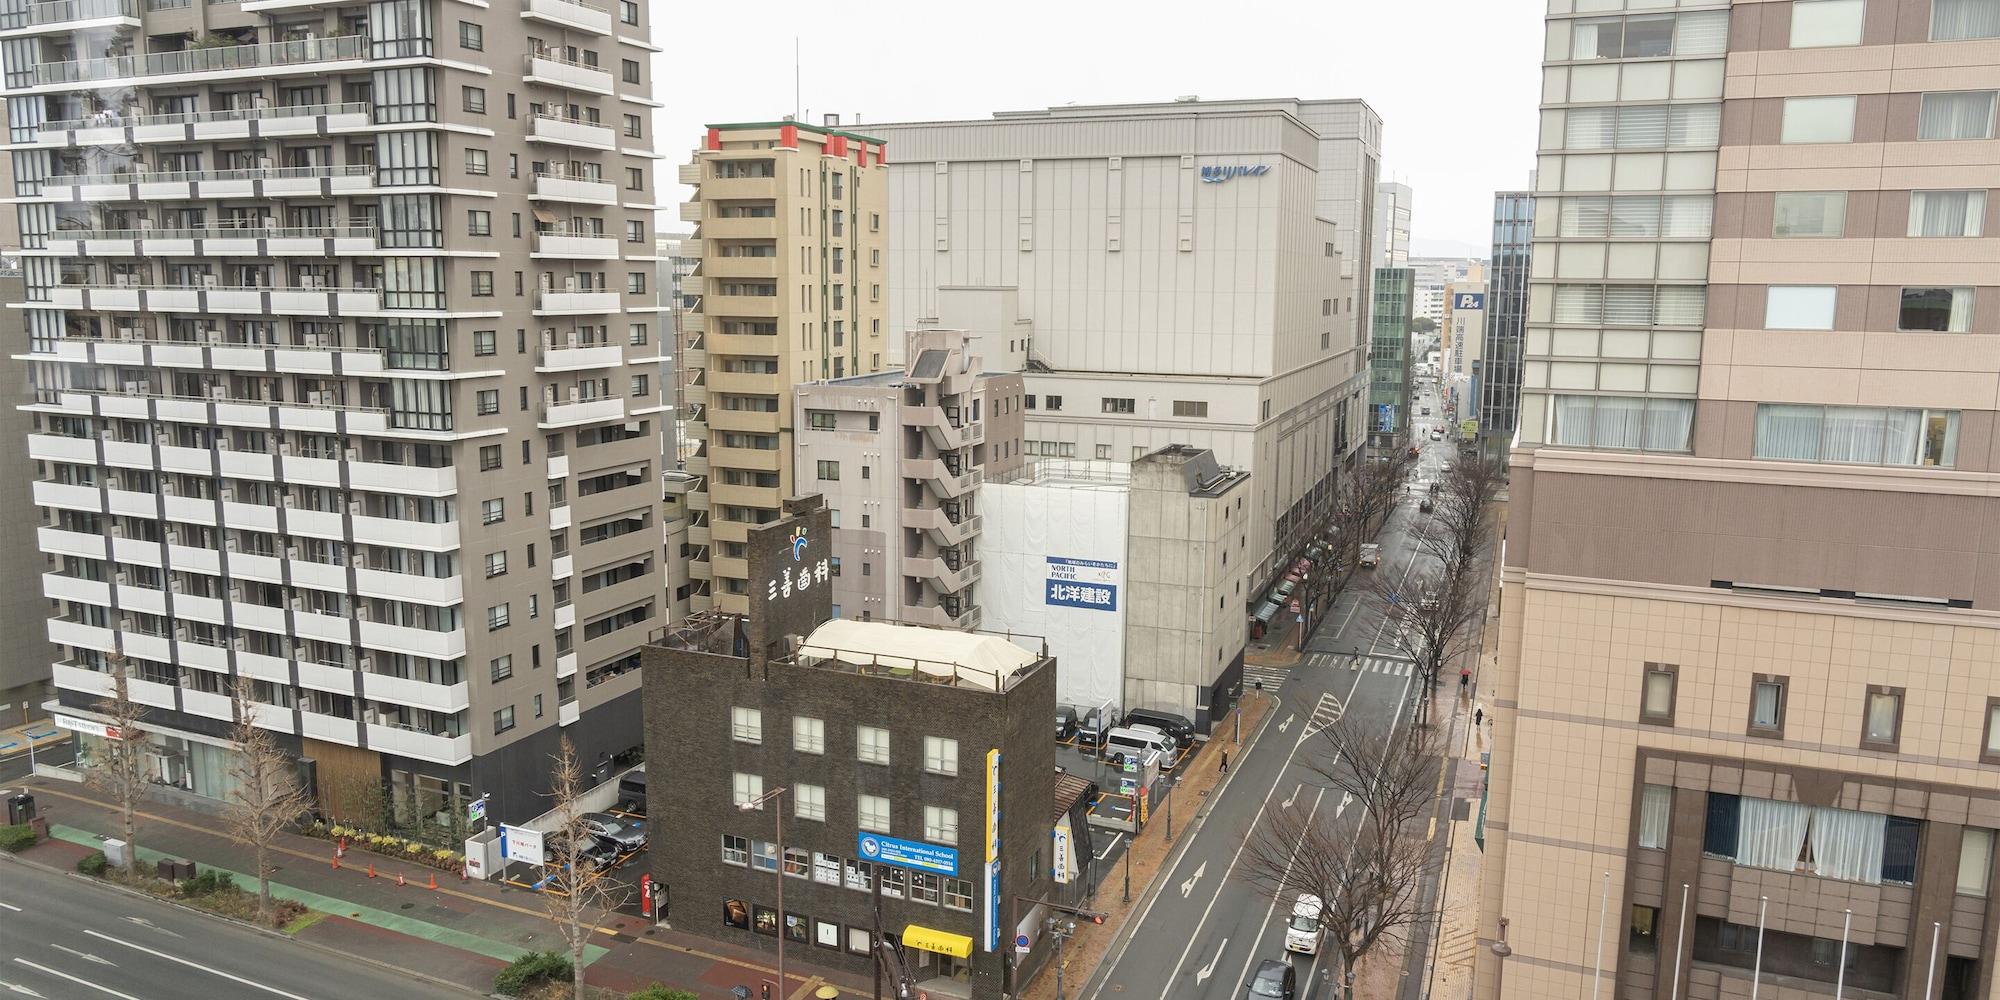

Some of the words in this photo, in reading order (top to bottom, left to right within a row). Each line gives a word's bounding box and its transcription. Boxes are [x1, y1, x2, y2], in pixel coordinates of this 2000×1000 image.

[1051, 564, 1075, 573] NORTH
[1051, 571, 1078, 580] PACIFIC
[1050, 584, 1111, 605] 北洋建設
[880, 840, 899, 849] Citrus
[899, 843, 935, 856] International
[935, 850, 954, 860] School
